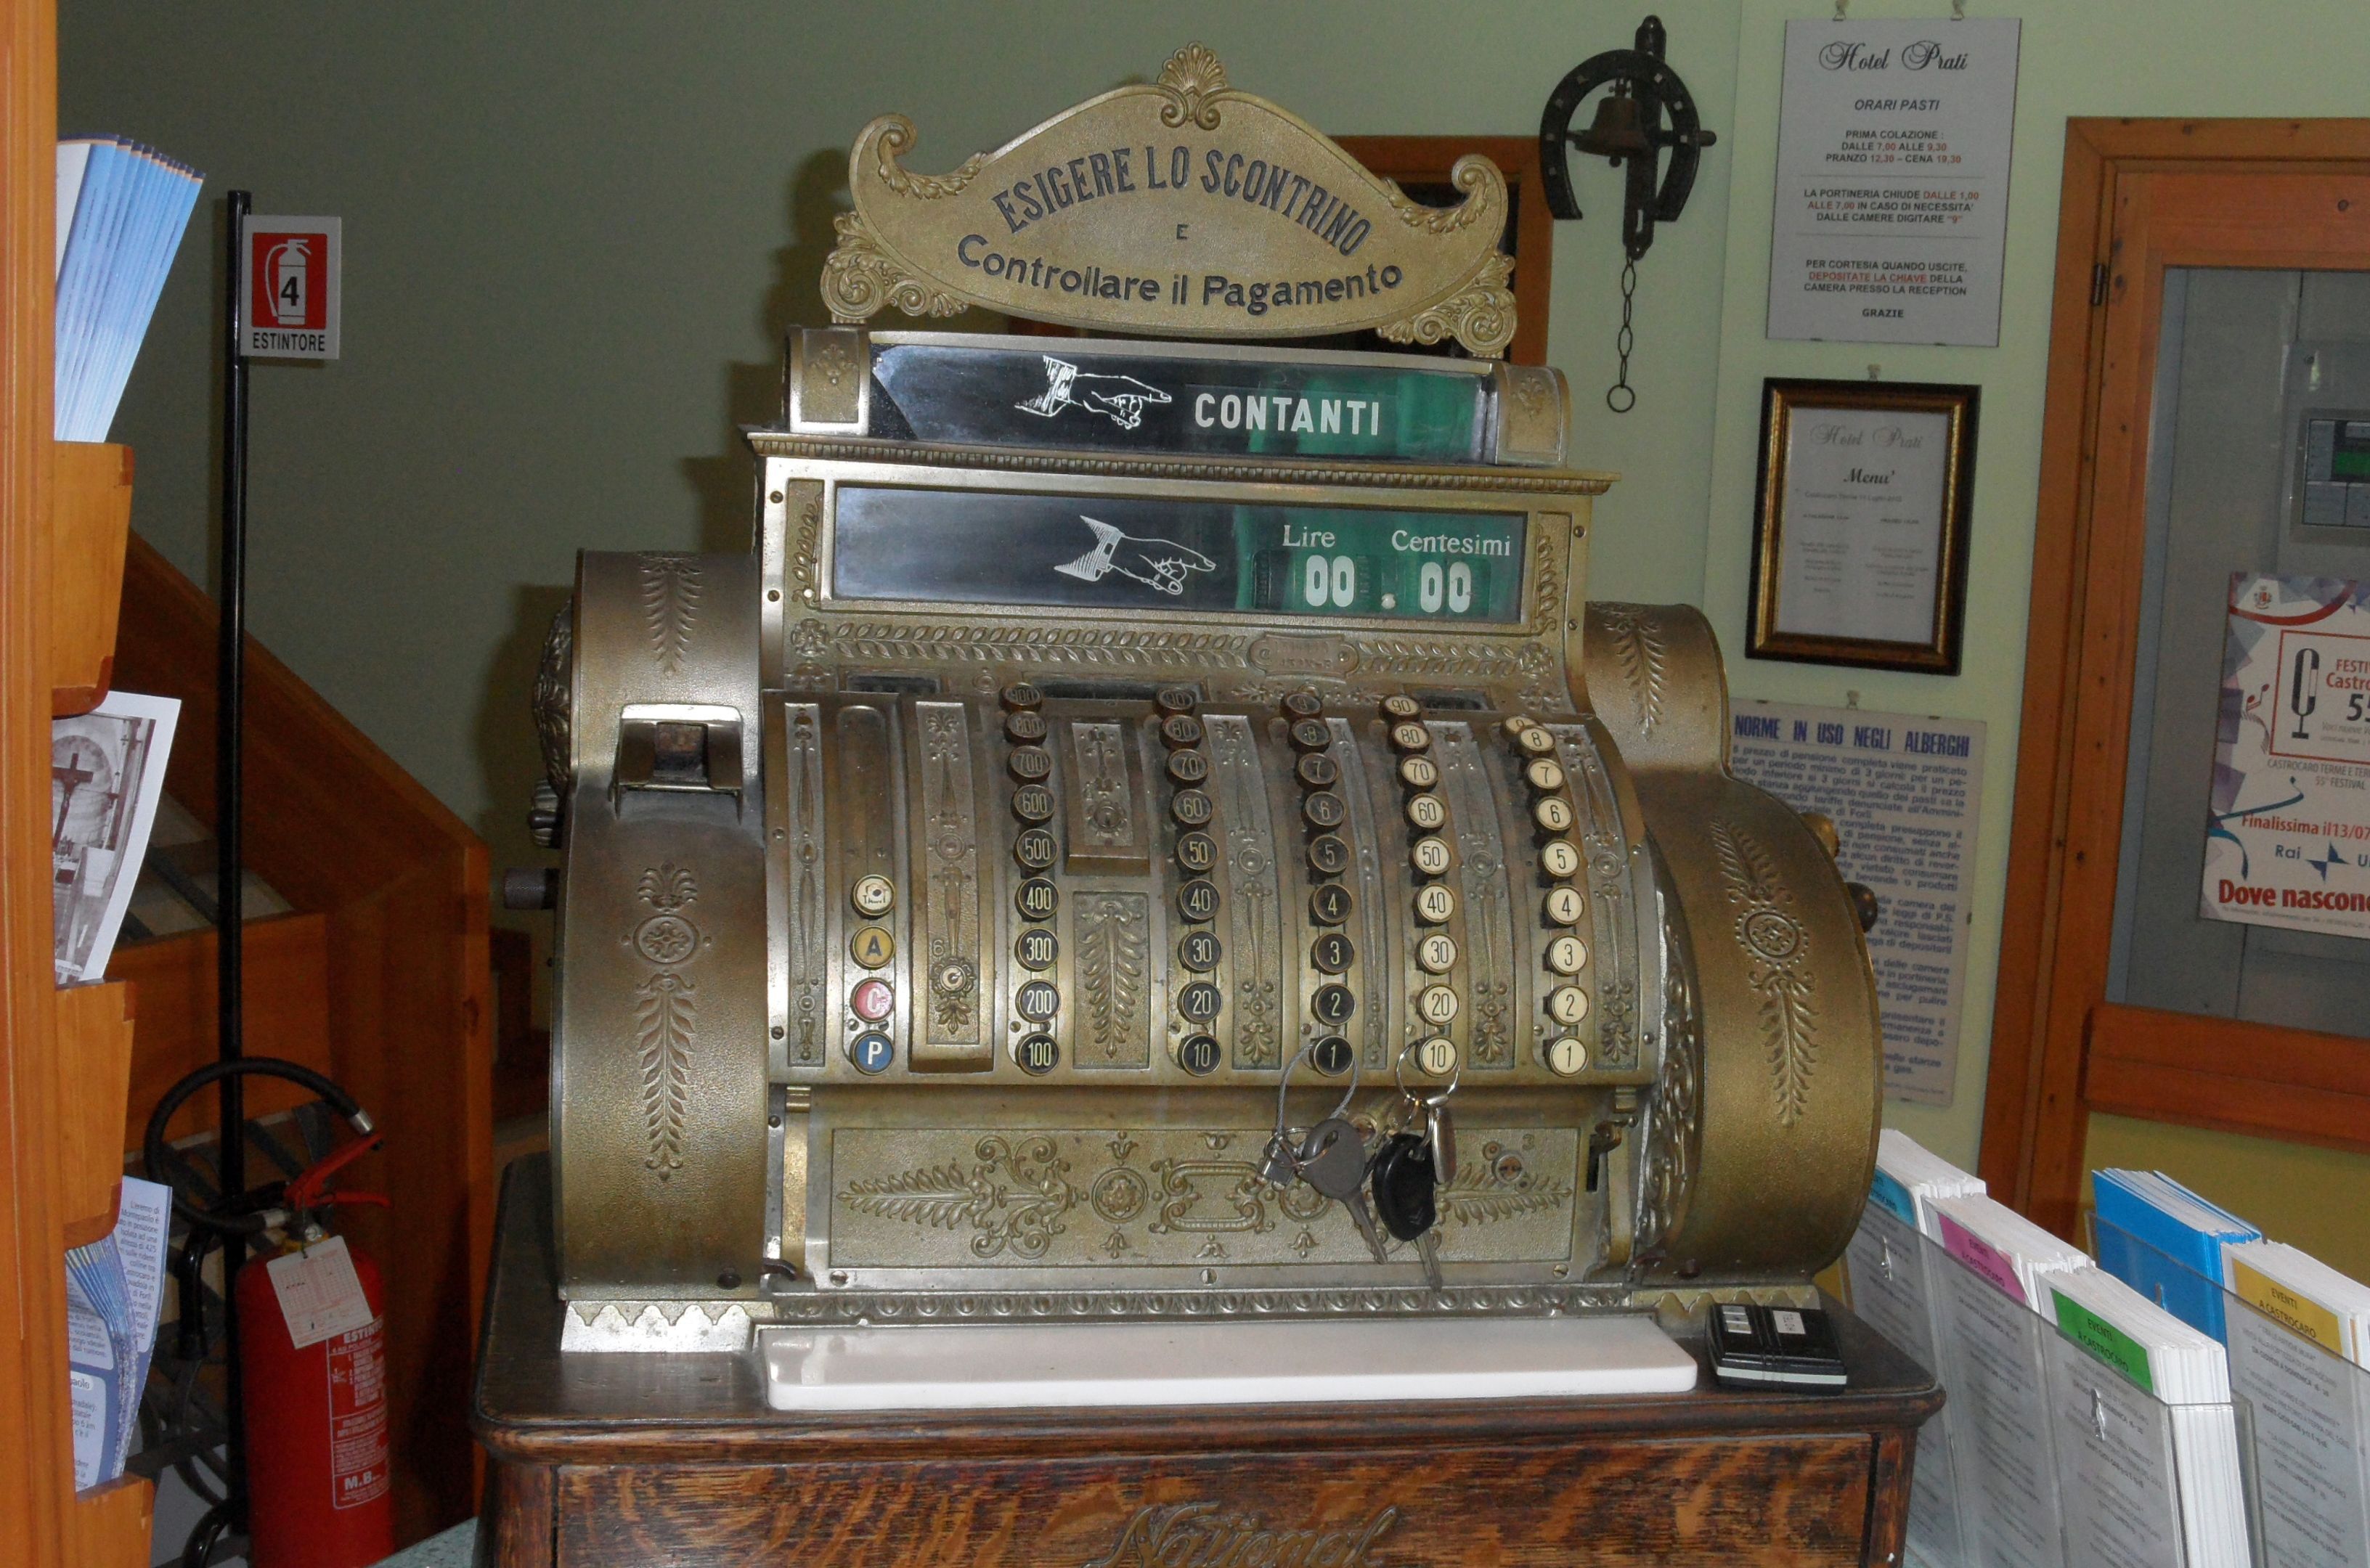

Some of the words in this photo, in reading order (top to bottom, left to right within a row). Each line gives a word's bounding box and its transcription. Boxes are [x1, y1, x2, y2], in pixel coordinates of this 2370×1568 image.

[1819, 41, 1889, 71] Hotel
[1902, 40, 1968, 70] Prati
[1854, 99, 1897, 111] ORARI
[1899, 99, 1940, 111] PASTI
[1845, 130, 1877, 140] PRIMA
[1879, 130, 1938, 140] COLAZIONE
[1841, 142, 1874, 152] DALLE
[1898, 142, 1925, 152] ALLE
[1825, 153, 1868, 163] PRANZO
[1905, 155, 1934, 165] CENA
[992, 147, 1131, 234] ESIGERE
[1145, 146, 1189, 192] LO
[1200, 149, 1374, 257] SCONTRINO
[1804, 189, 1817, 198] LA
[1820, 189, 1881, 199] PORTINERIA
[1884, 189, 1921, 200] CHIUDE
[1923, 191, 1957, 200] DALLE
[1807, 201, 1833, 211] ALLE
[1857, 202, 1867, 211] IN
[1870, 202, 1898, 212] CASO
[1816, 213, 1849, 222] DALLE
[1851, 213, 1894, 223] CAMERE
[1897, 213, 1945, 224] DIGITARE
[1176, 224, 1189, 240] E
[957, 233, 1160, 303] Controllare
[1173, 274, 1189, 304] il
[1202, 263, 1404, 316] Pagamento
[1806, 259, 1827, 269] PER
[1828, 259, 1879, 270] CORTESIA
[1881, 261, 1926, 271] QUANDO
[1804, 282, 1846, 293] CAMERA
[1849, 283, 1890, 294] PRESSO
[1892, 285, 1905, 294] LA
[1908, 286, 1967, 296] RECEPTION
[1809, 271, 1871, 282] DEPOSITATE
[1873, 272, 1887, 282] LA
[1889, 273, 1928, 283] CHIAVE
[1929, 274, 1963, 284] DELLA
[280, 276, 300, 306] 4
[1862, 308, 1905, 319] GRAZIE
[253, 332, 326, 352] ESTINTORE
[1194, 392, 1380, 436] CONTANTI
[1282, 524, 1336, 548] Lire
[1391, 530, 1511, 557] Centesimi
[2336, 658, 2370, 674] FESTI
[1170, 693, 1186, 705] 90
[1392, 700, 1412, 713] 90
[1017, 718, 1040, 735] 800
[1173, 722, 1192, 738] 80
[1307, 727, 1317, 741] 8
[1401, 728, 1420, 744] 80
[1735, 715, 1780, 739] NORME
[1793, 720, 1808, 742] IN
[1817, 722, 1844, 746] USO
[1854, 725, 1891, 751] NEGLI
[1905, 730, 1971, 758] ALBERGHI
[1531, 731, 1542, 747] 8
[1018, 753, 1043, 772] 700
[1180, 757, 1199, 775] 70
[1314, 761, 1322, 779] 7
[1410, 763, 1430, 782] 70
[2267, 759, 2319, 773] CASTROCARO
[2320, 762, 2347, 777] TERME
[1539, 767, 1550, 785] 7
[2330, 776, 2366, 791] FESTIVAL
[1022, 793, 1048, 813] 600
[1184, 798, 1203, 817] 60
[1319, 799, 1330, 821] 6
[1417, 802, 1437, 822] 60
[1550, 804, 1561, 824] 6
[2241, 813, 2319, 835] Finalissima
[1025, 838, 1051, 860] 500
[1189, 841, 1208, 864] 50
[1325, 843, 1335, 866] 5
[1422, 845, 1441, 867] 50
[1556, 847, 1567, 870] 5
[2275, 844, 2301, 859] Rai
[2357, 854, 2370, 867] U
[1026, 887, 1051, 910] 400
[1190, 888, 1212, 912] 40
[1327, 893, 1337, 916] 4
[1427, 891, 1446, 914] 40
[2219, 879, 2276, 907] Dove
[1561, 894, 1572, 917] 4
[865, 935, 882, 957] A
[1026, 937, 1051, 962] 300
[1193, 938, 1212, 963] 30
[1330, 942, 1340, 965] 3
[1430, 940, 1450, 964] 30
[1563, 944, 1573, 967] 3
[866, 987, 883, 1013] C
[1027, 989, 1052, 1014] 200
[1192, 990, 1212, 1015] 20
[1331, 993, 1341, 1017] 2
[1431, 992, 1450, 1017] 20
[1565, 994, 1575, 1017] 2
[867, 1041, 883, 1065] P
[1028, 1042, 1052, 1066] 100
[1194, 1044, 1211, 1068] 10
[1330, 1044, 1337, 1068] 1
[1430, 1045, 1446, 1069] 10
[1566, 1045, 1573, 1069] 1
[2271, 1287, 2297, 1310] EVENTI
[2087, 1318, 2114, 1342] EVENTI
[2259, 1299, 2266, 1309] A
[2266, 1303, 2317, 1339] CASTROCARO
